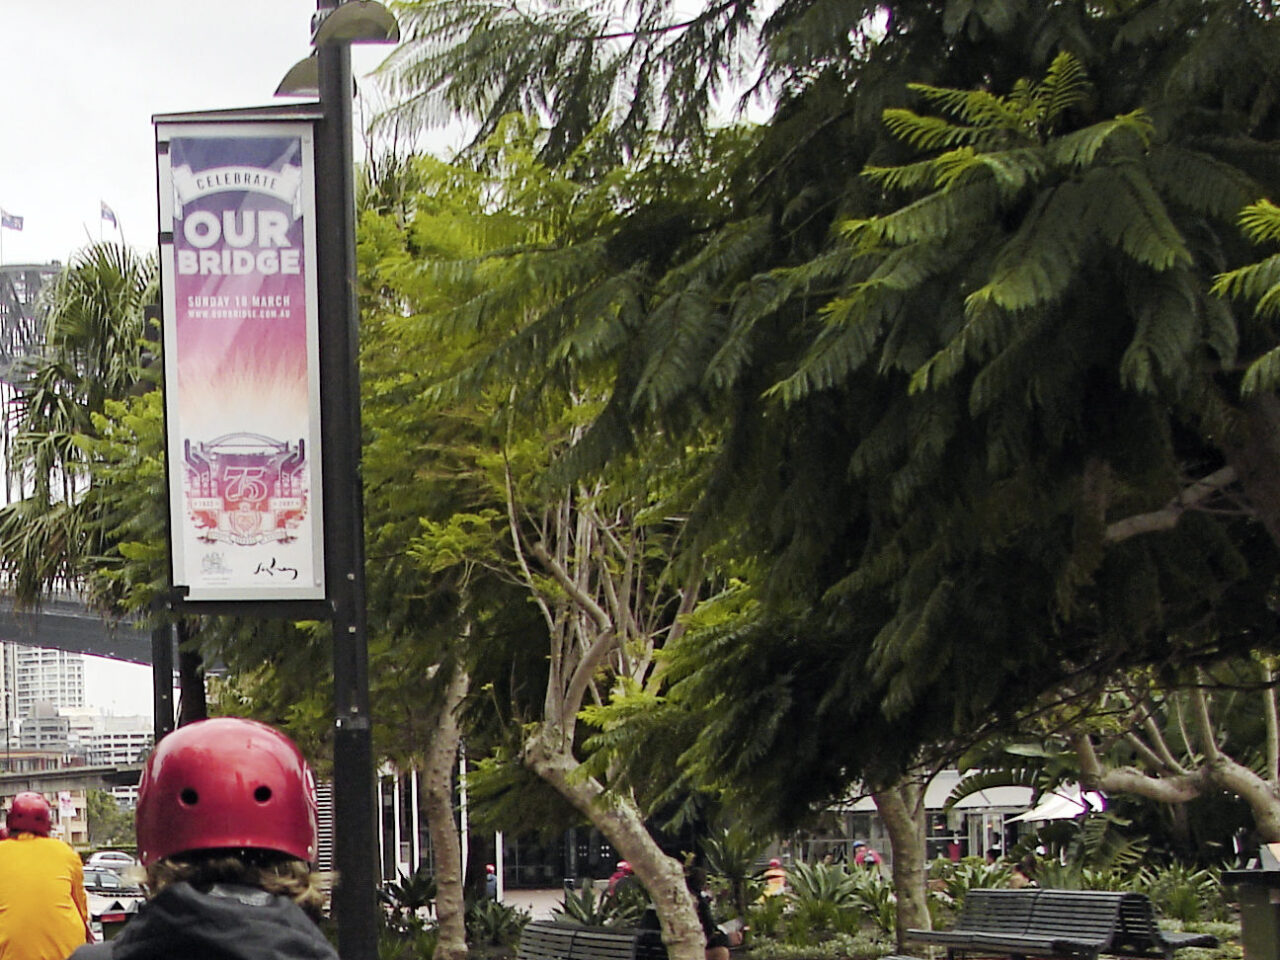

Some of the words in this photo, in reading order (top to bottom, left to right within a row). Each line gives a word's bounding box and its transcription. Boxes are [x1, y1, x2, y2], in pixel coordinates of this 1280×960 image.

[196, 172, 277, 191] CELEBRATE
[184, 210, 292, 249] OUR
[177, 249, 300, 275] BRIDGE
[188, 296, 229, 308] SUNDAY
[252, 296, 290, 308] MARCH
[224, 466, 268, 502] 75
